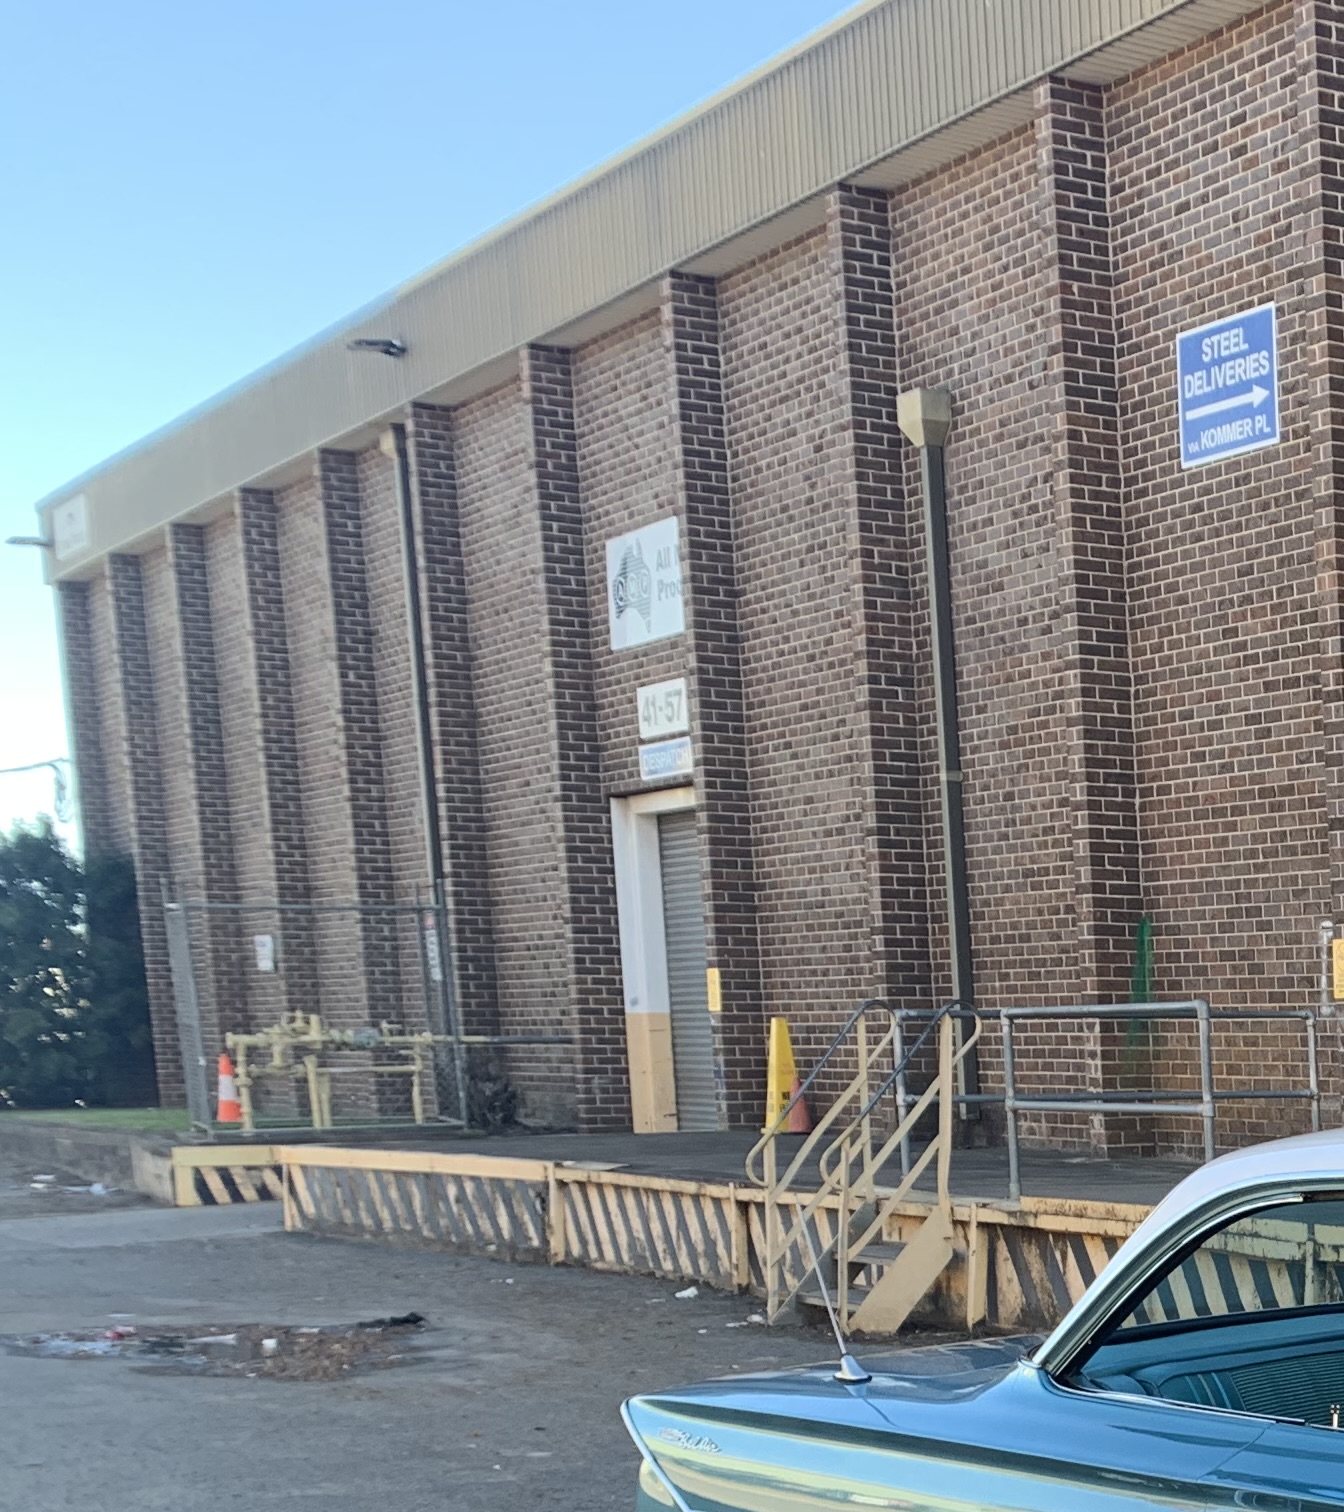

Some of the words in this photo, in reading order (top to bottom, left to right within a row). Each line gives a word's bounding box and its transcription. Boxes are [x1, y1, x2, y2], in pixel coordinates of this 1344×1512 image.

[1202, 327, 1249, 362] STEEL
[1184, 350, 1270, 398] DELIVERIES
[1200, 417, 1253, 451] KOMMER
[1255, 413, 1271, 435] PL
